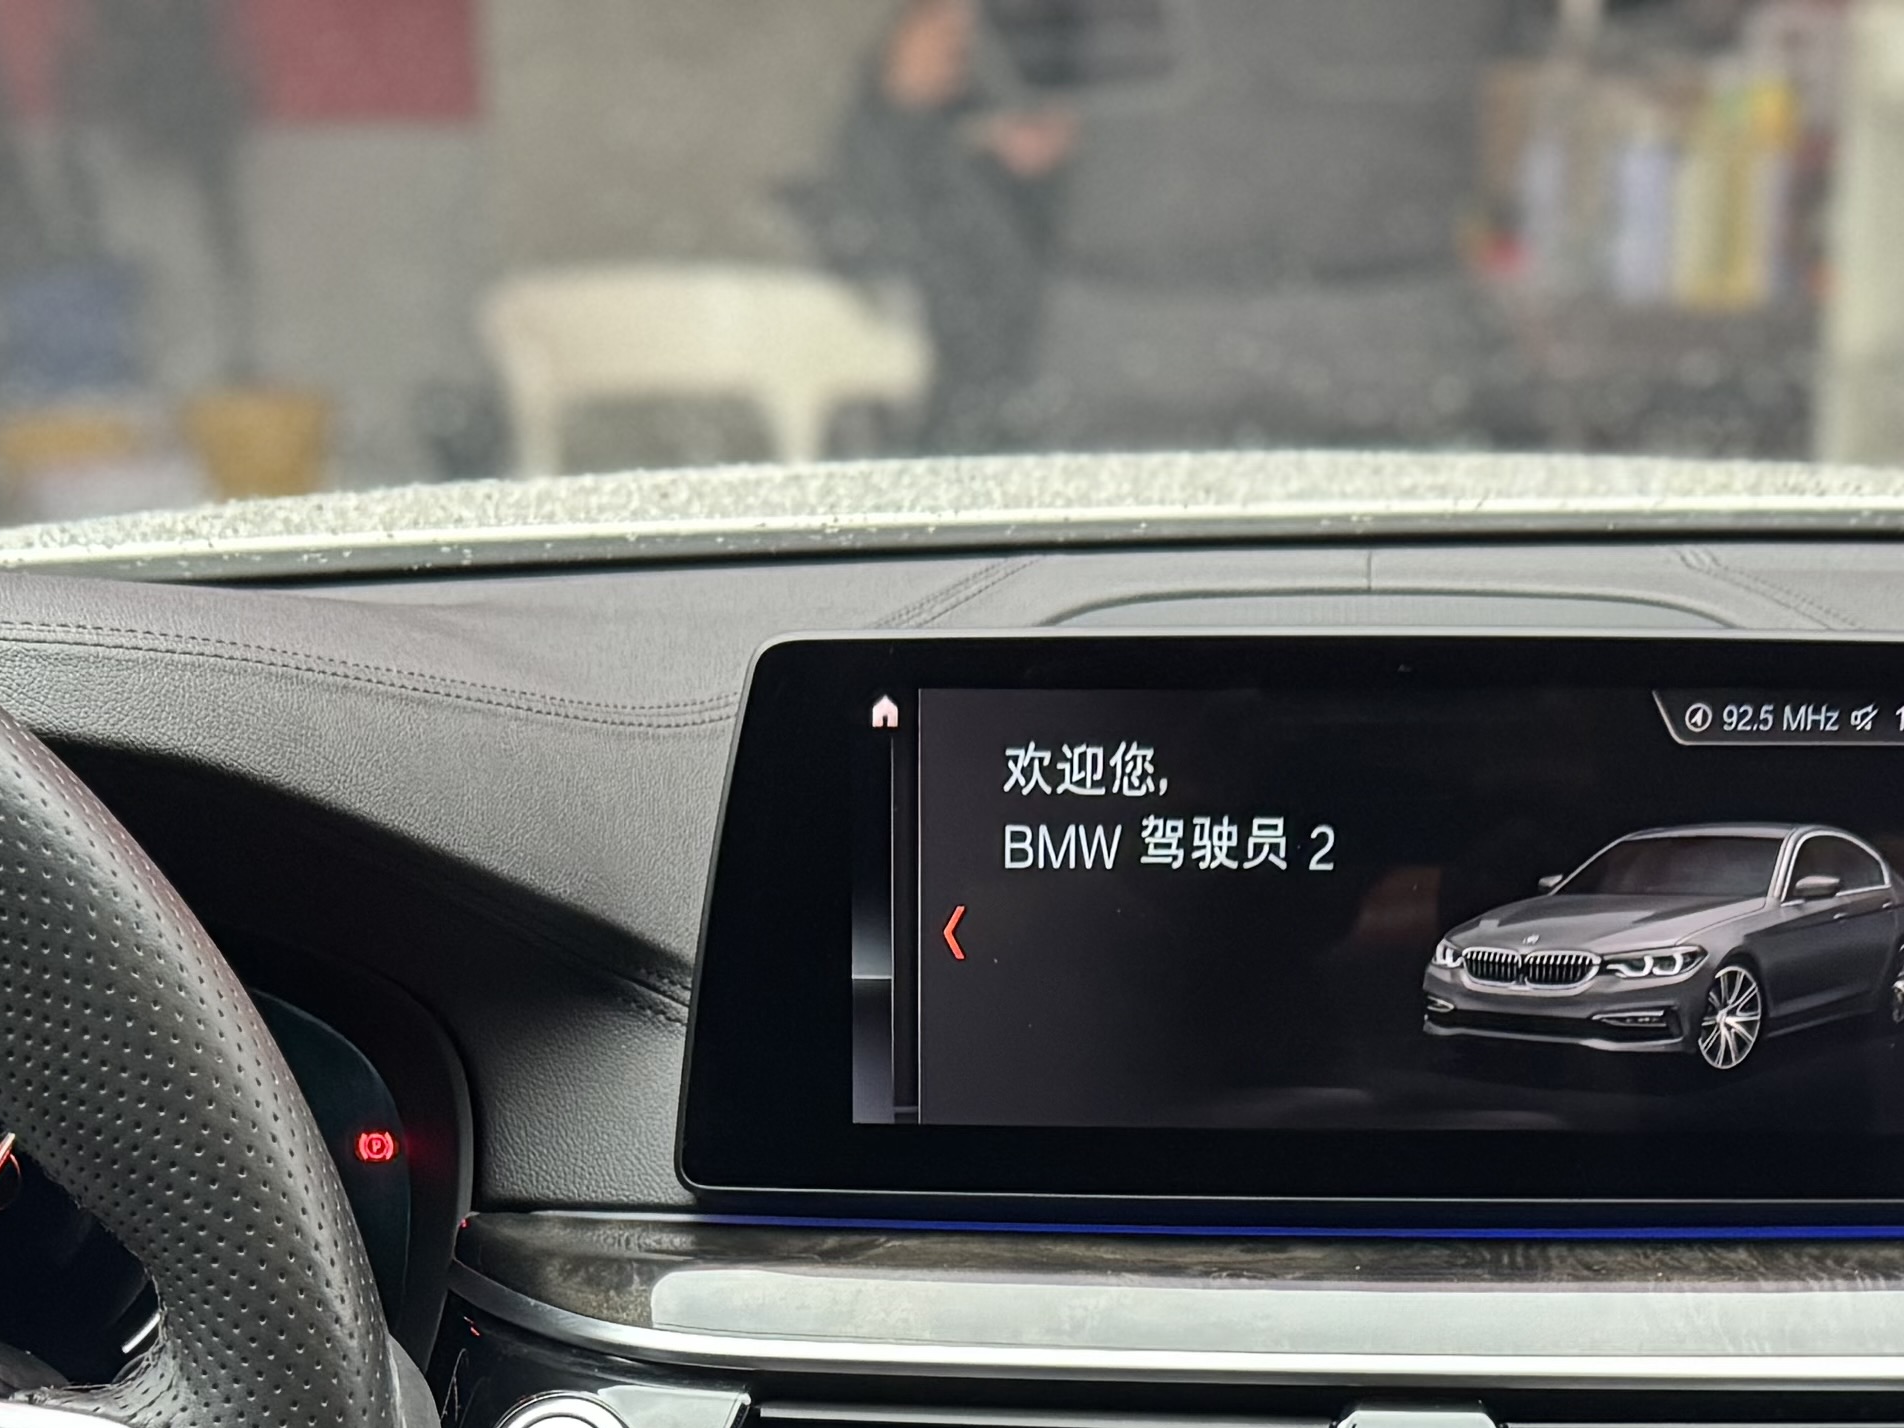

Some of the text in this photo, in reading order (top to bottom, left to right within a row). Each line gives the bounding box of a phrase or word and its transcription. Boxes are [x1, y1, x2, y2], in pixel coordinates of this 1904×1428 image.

[1722, 703, 1841, 731] 92.5 MHz
[1003, 814, 1336, 872] BMW 驾驶员 2
